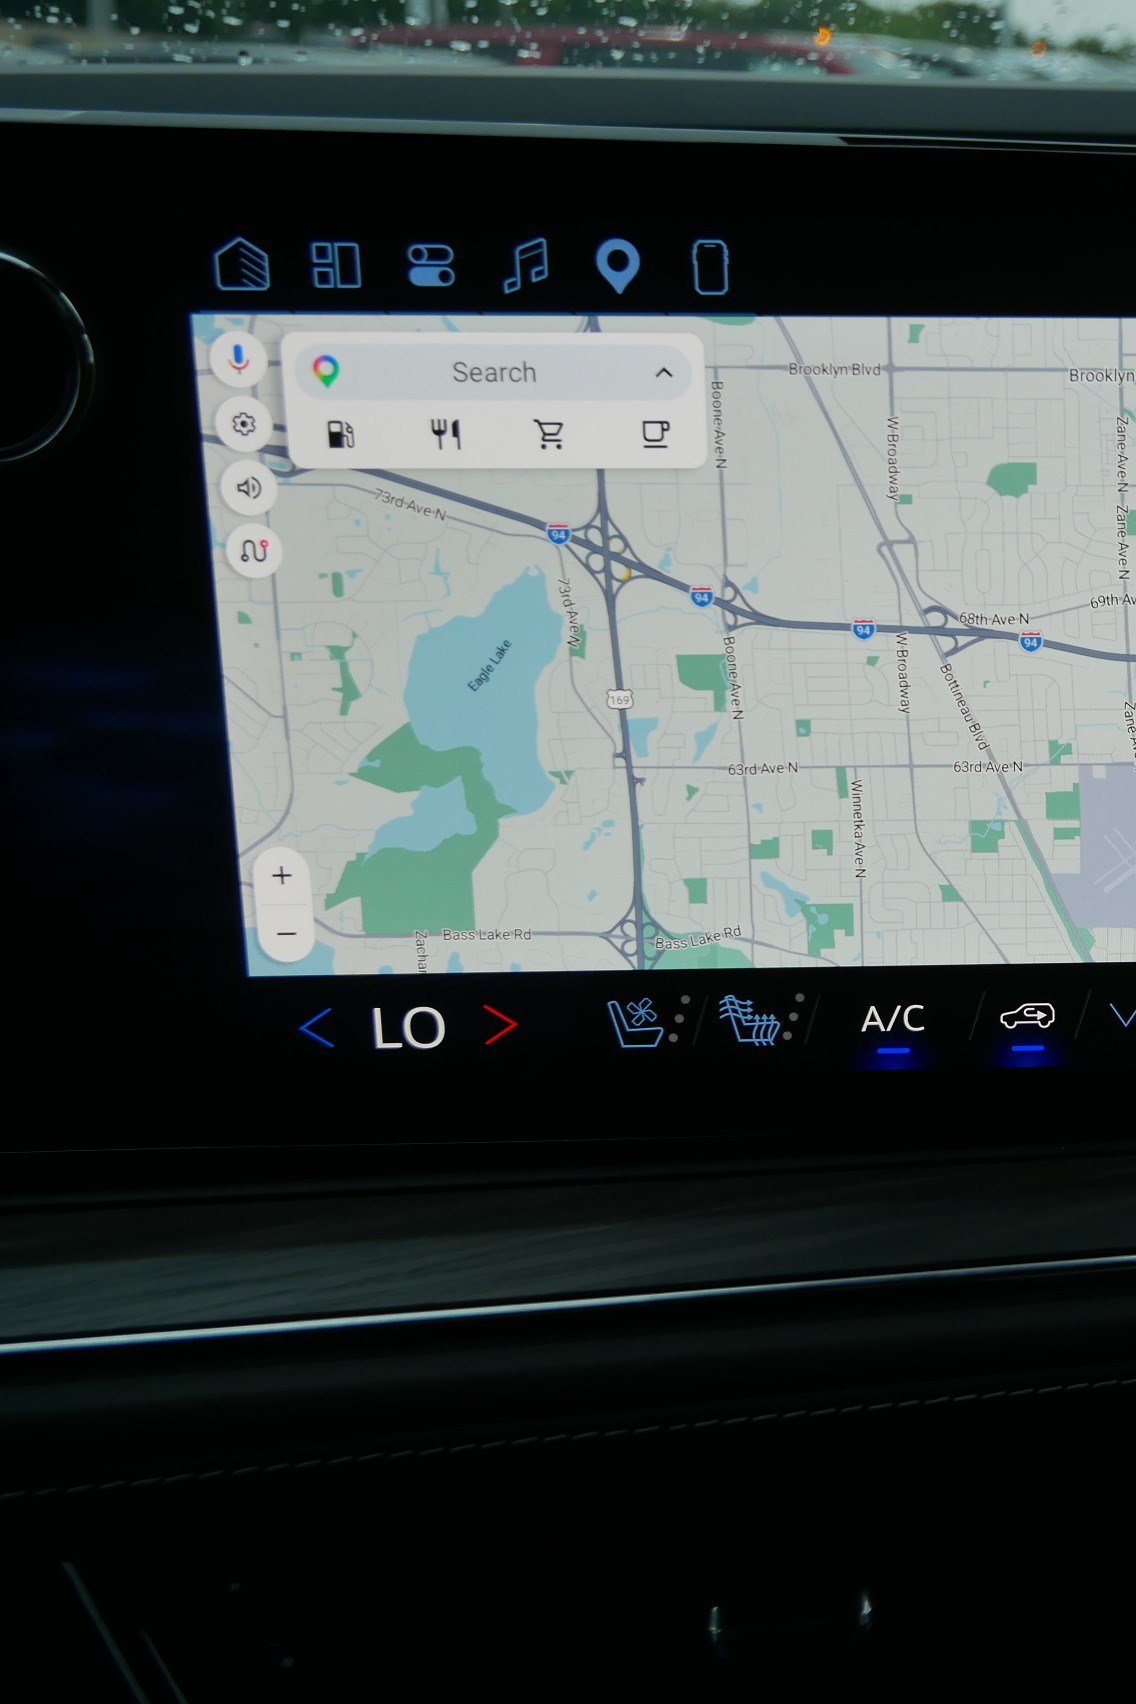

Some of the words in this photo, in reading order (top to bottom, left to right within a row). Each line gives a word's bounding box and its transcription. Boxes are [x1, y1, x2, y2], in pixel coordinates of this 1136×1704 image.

[453, 361, 536, 384] Search
[789, 363, 849, 377] Brooklyn
[852, 363, 881, 376] Blvd
[1069, 368, 1135, 384] Brooklyn
[711, 380, 723, 425] Boone
[887, 416, 898, 432] W
[1116, 416, 1128, 448] Zane
[714, 428, 726, 454] Ave
[716, 458, 727, 469] N
[886, 433, 899, 502] Broadway
[1117, 451, 1128, 476] Ave
[1118, 482, 1128, 492] N
[373, 488, 404, 509] 73rd
[407, 500, 432, 517] Ave
[434, 507, 447, 521] N
[1116, 505, 1128, 537] Zane
[552, 529, 566, 540] 94
[1118, 537, 1128, 563] Ave
[1119, 569, 1130, 580] N
[558, 578, 573, 608] 73rd
[695, 592, 709, 603] 94
[1090, 594, 1118, 608] 69th
[567, 612, 579, 634] Ave
[858, 625, 870, 634] 94
[959, 612, 987, 626] 68th
[989, 612, 1014, 626] Ave
[1018, 613, 1030, 625] N
[566, 635, 580, 647] N
[896, 632, 908, 647] W
[1024, 638, 1037, 648] 94
[467, 663, 494, 692] Eagle
[490, 638, 512, 667] Lake
[724, 636, 738, 677] Boone
[728, 678, 741, 706] Ave
[896, 650, 910, 714] Broadway
[610, 695, 629, 706] 169
[940, 663, 974, 725] Bottineau
[967, 721, 990, 751] Blvd
[732, 708, 744, 720] N
[728, 762, 758, 775] 63rd
[761, 762, 784, 774] Ave
[788, 762, 798, 774] N
[954, 760, 982, 773] 63rd
[986, 760, 1009, 773] Ave
[1013, 761, 1023, 772] N
[851, 779, 865, 838] Winnetka
[853, 842, 866, 865] Ave
[855, 867, 866, 878] N
[443, 929, 475, 941] Bass
[479, 929, 507, 941] Lake
[513, 929, 532, 941] Rd
[655, 937, 687, 950] Bass
[690, 931, 720, 947] Lake
[722, 926, 742, 939] Rd
[373, 1006, 445, 1049] LO
[861, 1005, 925, 1032] A/C
